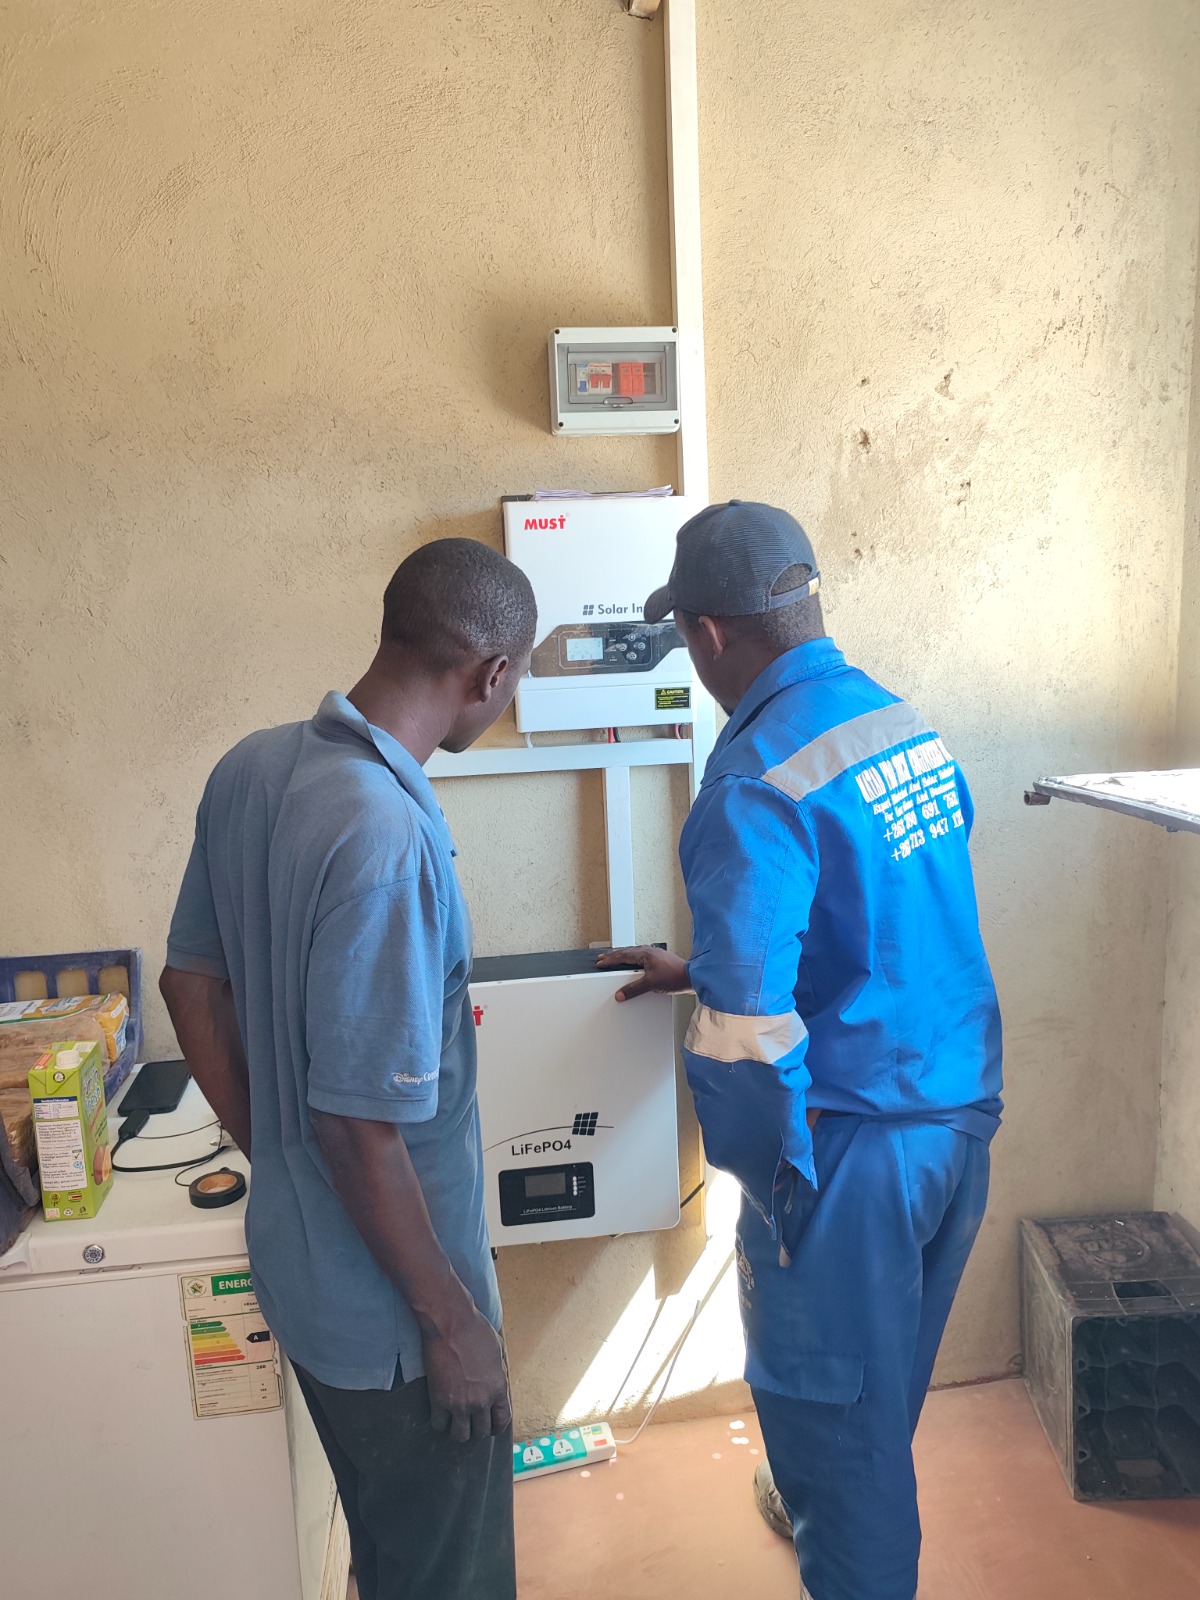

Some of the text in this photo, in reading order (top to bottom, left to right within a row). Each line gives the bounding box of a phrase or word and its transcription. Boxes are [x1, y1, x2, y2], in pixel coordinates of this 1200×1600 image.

[524, 515, 566, 530] MUST
[597, 602, 644, 615] Solar In
[511, 1139, 572, 1156] LiFePO4
